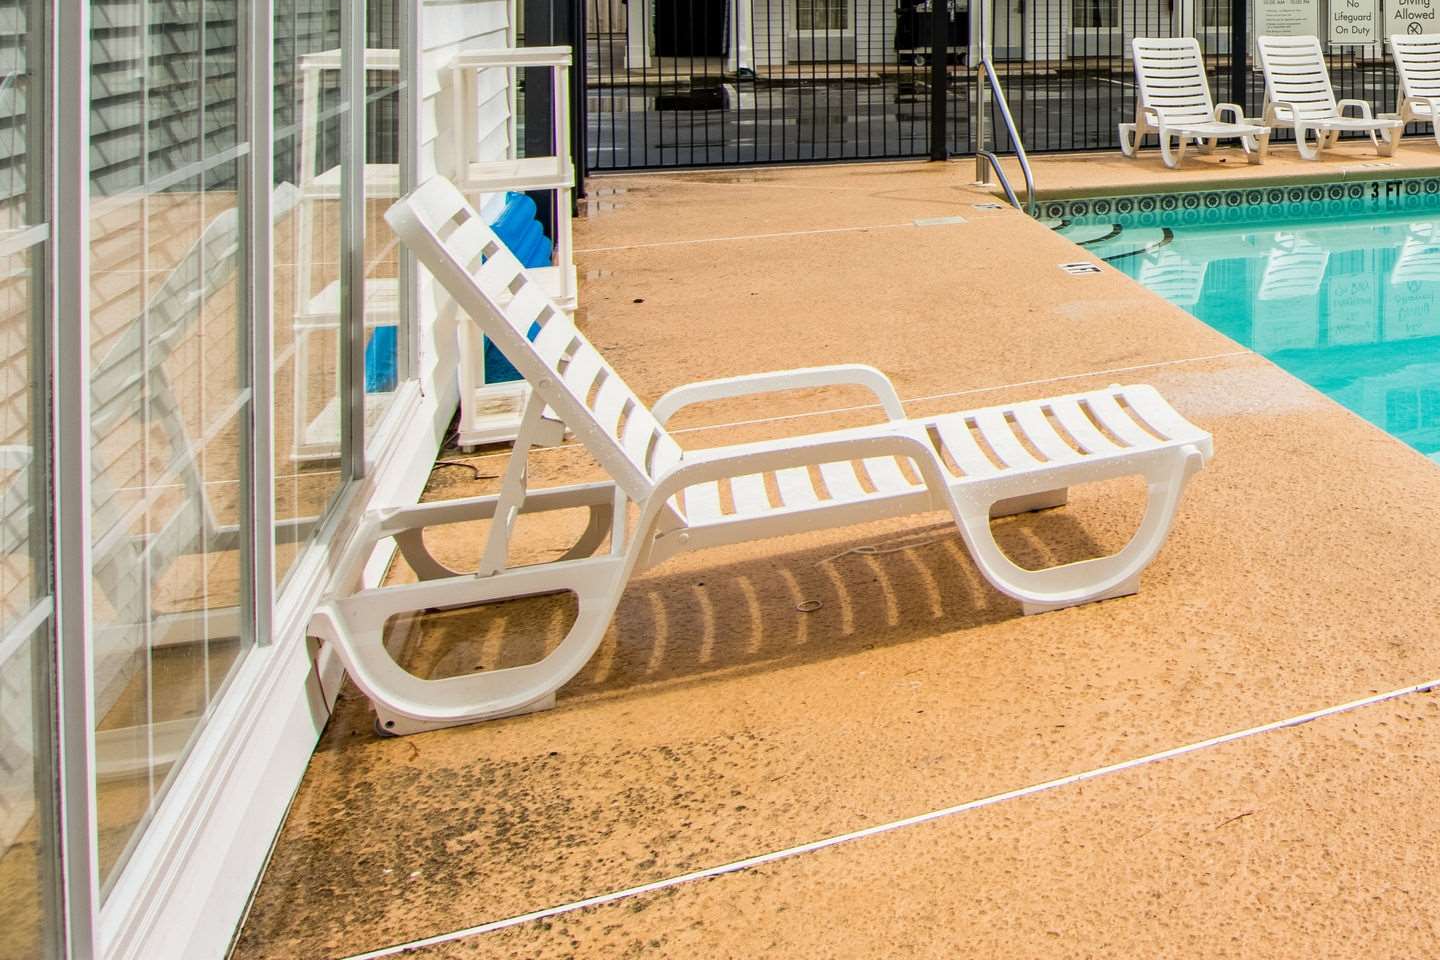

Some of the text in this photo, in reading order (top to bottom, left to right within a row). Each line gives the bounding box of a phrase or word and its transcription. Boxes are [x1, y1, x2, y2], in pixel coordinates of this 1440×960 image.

[1346, 0, 1360, 8] No
[1334, 12, 1372, 22] Lifeguard
[1393, 8, 1435, 20] Allowed
[1335, 26, 1370, 36] On Duty
[1371, 180, 1403, 198] 3 FT
